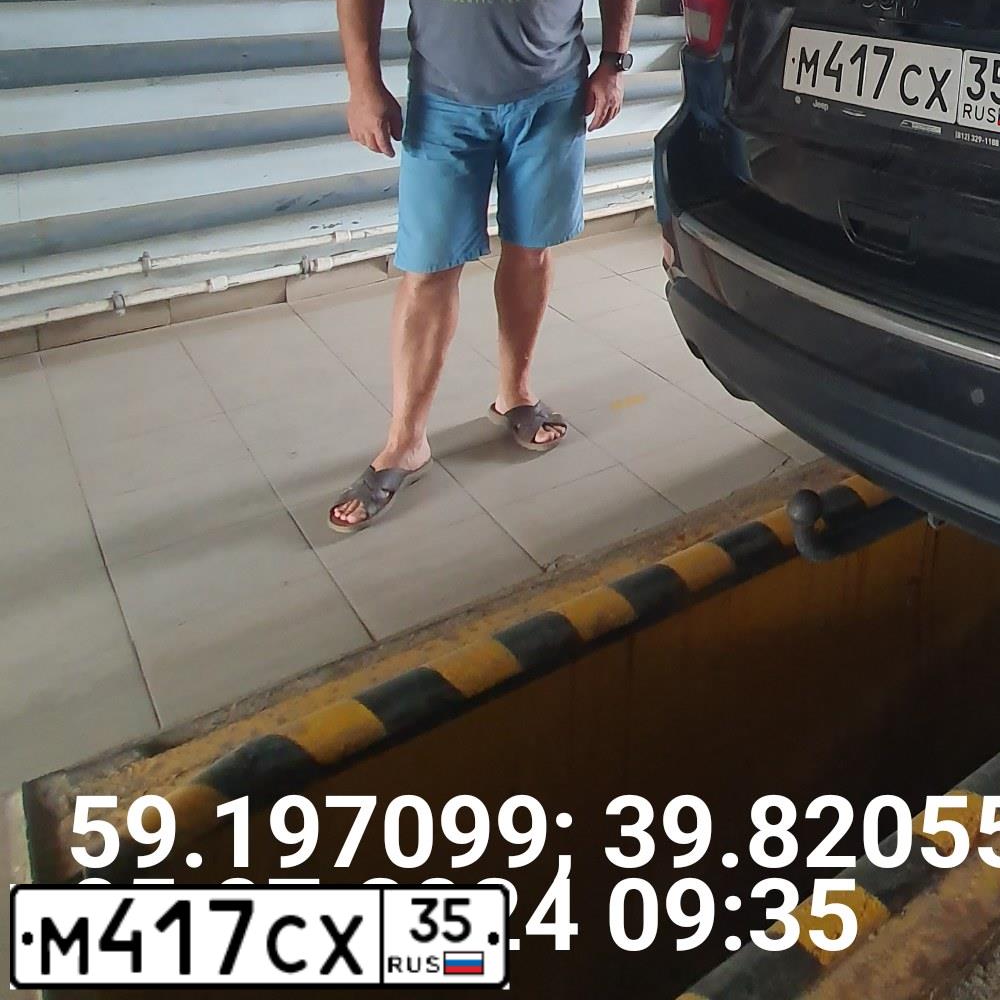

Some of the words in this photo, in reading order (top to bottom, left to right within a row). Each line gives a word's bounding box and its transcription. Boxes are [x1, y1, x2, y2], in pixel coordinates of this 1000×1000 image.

[796, 40, 953, 113] М417СХ
[812, 98, 829, 113] Jeep
[962, 103, 996, 124] RUS
